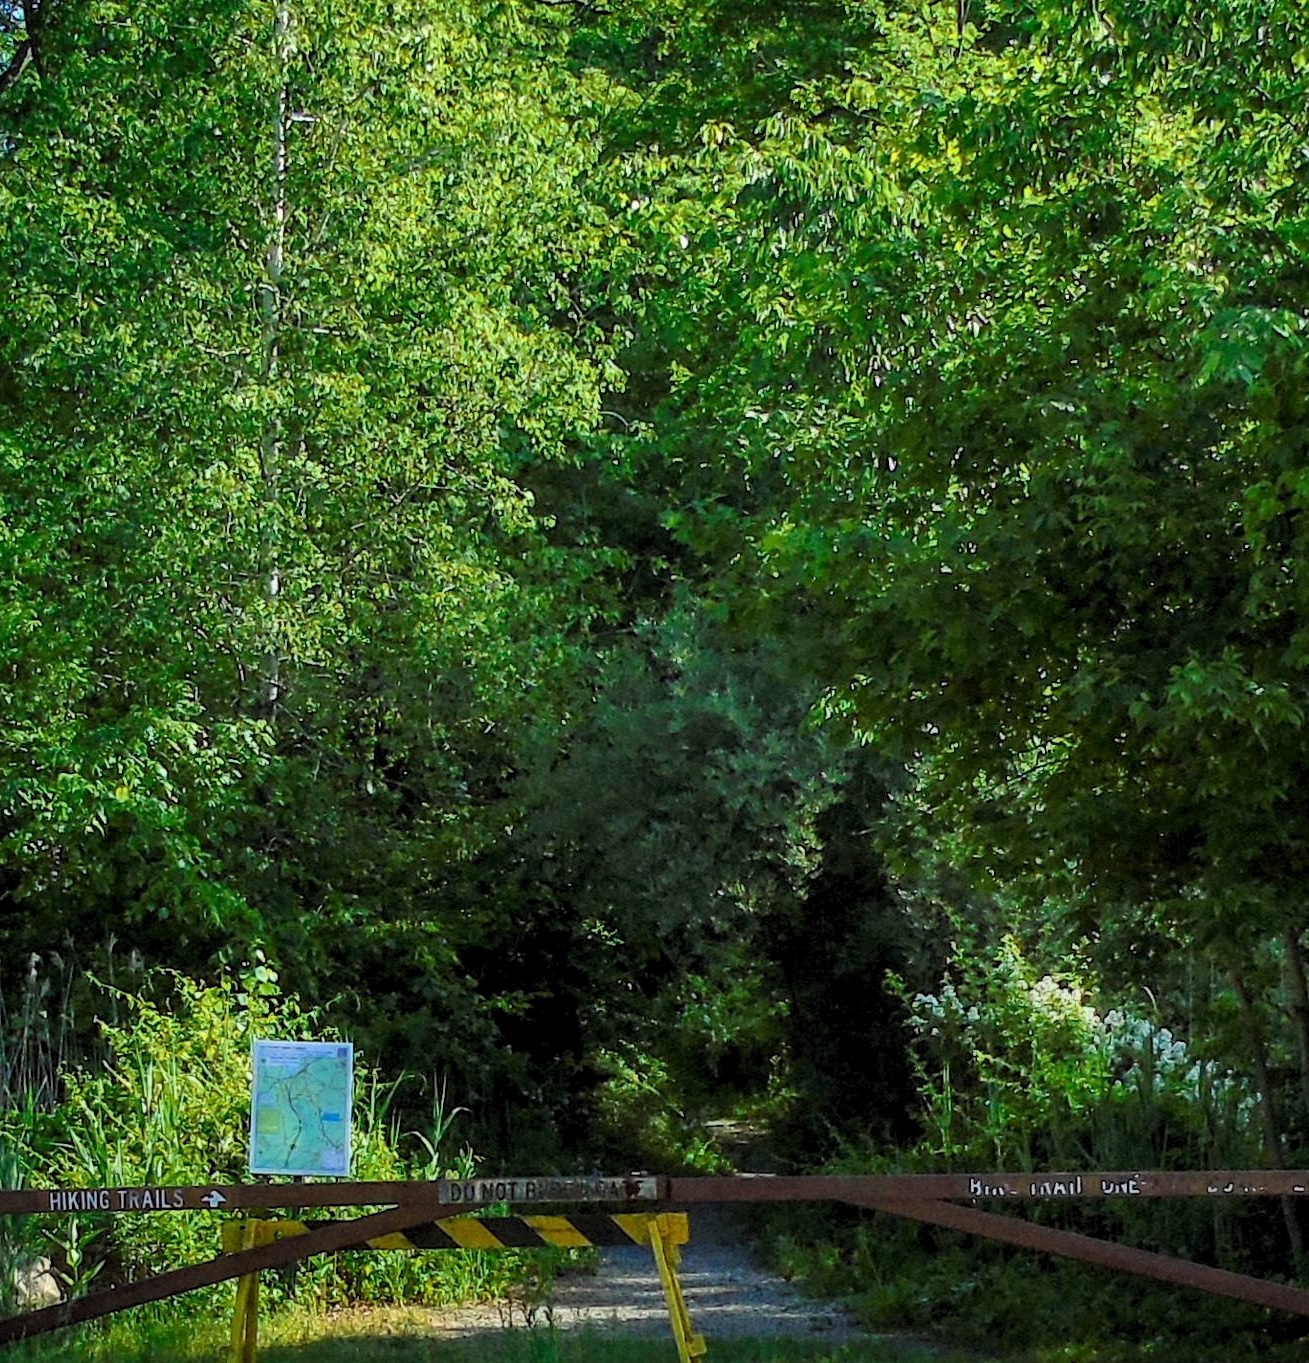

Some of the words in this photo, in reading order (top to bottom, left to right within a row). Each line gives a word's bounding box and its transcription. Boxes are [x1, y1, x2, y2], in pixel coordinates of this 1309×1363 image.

[49, 1190, 109, 1211] HIKING
[117, 1189, 184, 1209] TRAILS
[450, 1182, 475, 1202] DO
[482, 1181, 518, 1201] NOT
